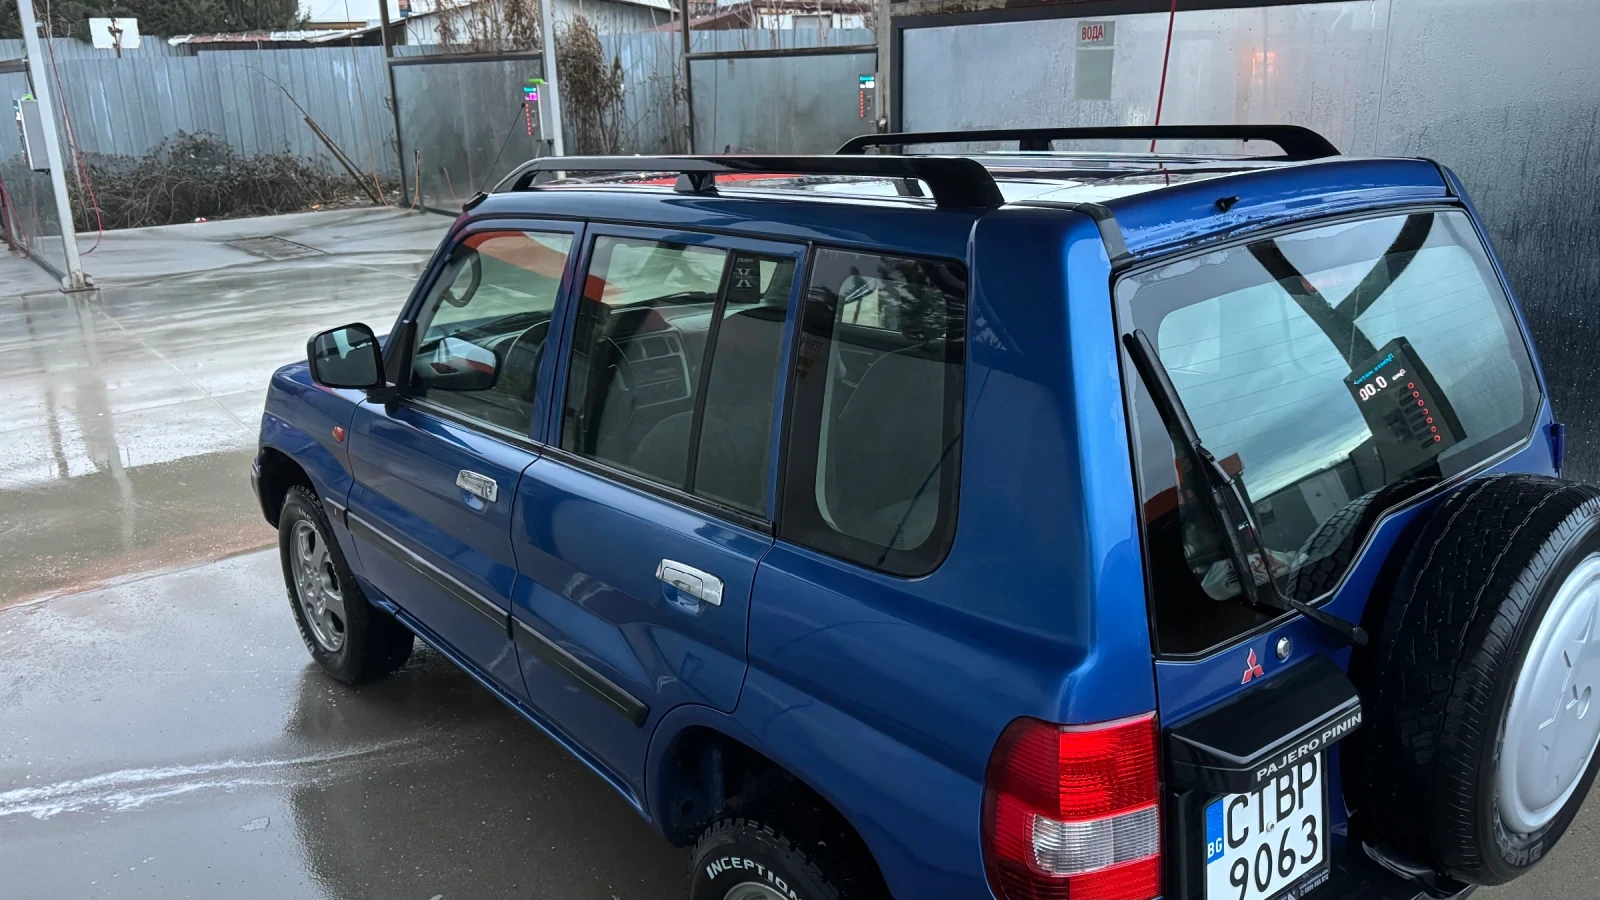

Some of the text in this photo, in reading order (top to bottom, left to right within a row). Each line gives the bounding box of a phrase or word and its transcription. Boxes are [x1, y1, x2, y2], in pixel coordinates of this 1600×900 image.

[1082, 25, 1104, 42] ВОДА
[1257, 712, 1362, 782] PAJERO PININ
[1207, 837, 1223, 860] BG
[1229, 814, 1318, 900] 9063
